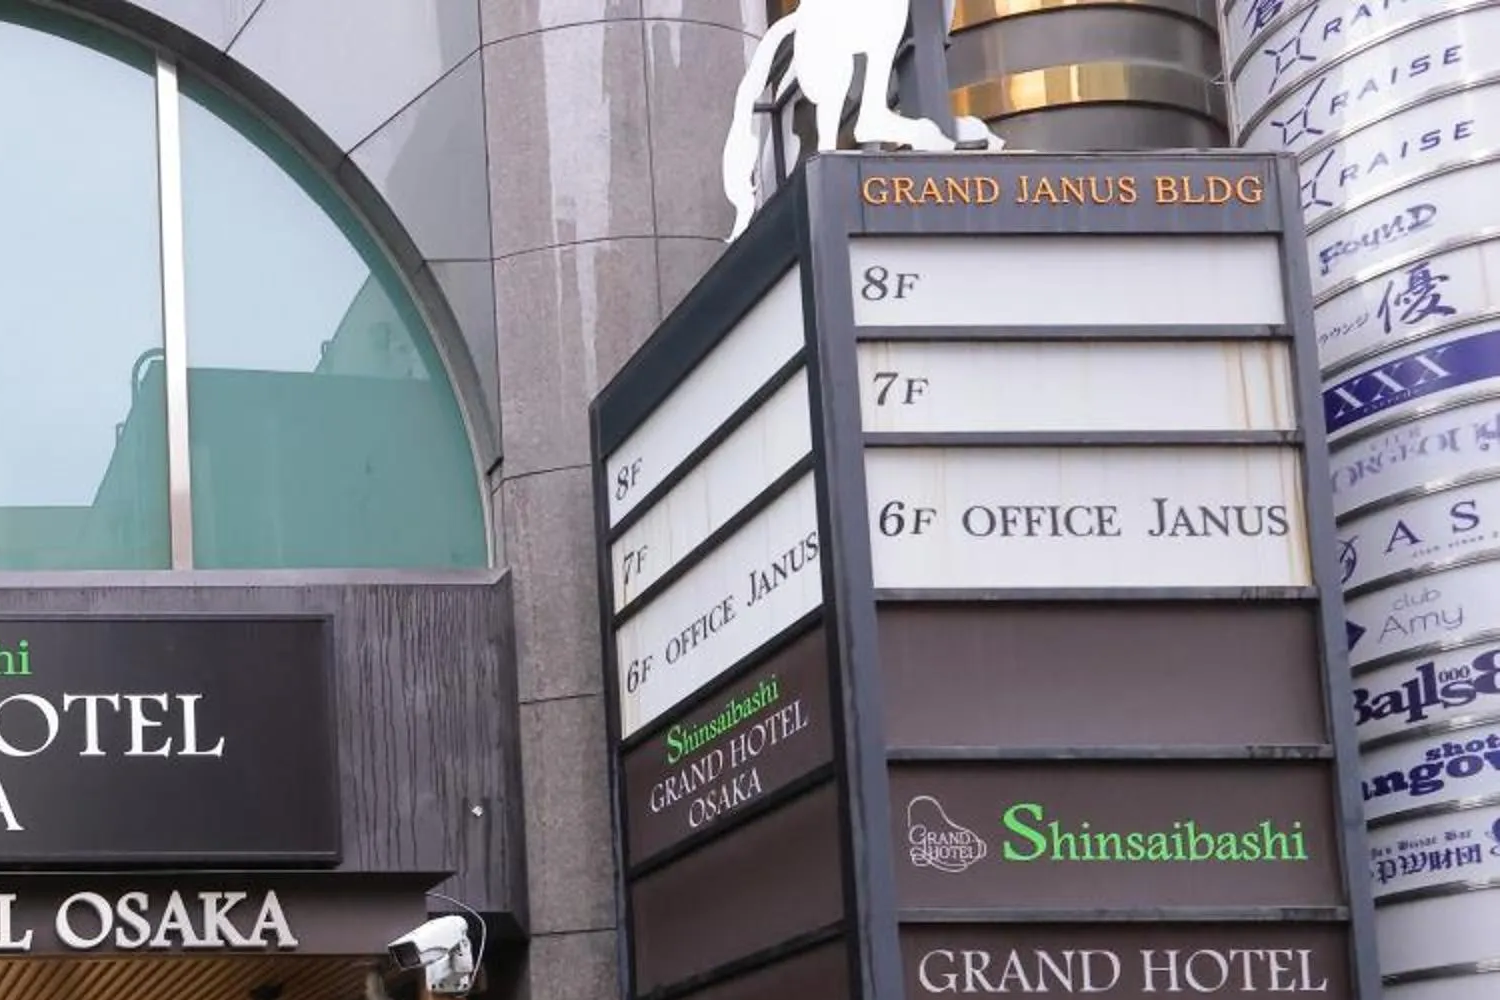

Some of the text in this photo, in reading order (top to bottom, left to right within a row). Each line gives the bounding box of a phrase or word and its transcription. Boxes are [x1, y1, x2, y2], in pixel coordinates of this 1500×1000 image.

[1329, 44, 1462, 116] RAISE
[1339, 119, 1474, 188] RAISE
[862, 175, 1263, 206] GRAND JANUS BLDG
[861, 266, 920, 301] 8F
[1377, 262, 1457, 334] 優
[873, 372, 929, 406] 7F
[1334, 348, 1451, 419] XXX
[615, 458, 643, 501] 8F
[878, 498, 1290, 538] 6F OFFICE JANUS
[623, 545, 648, 586] 7F
[627, 532, 819, 693] 6F OFFICE JANUS
[1378, 605, 1464, 643] Amy
[1393, 587, 1442, 611] club
[666, 674, 779, 764] Shinsaibashi
[650, 700, 810, 813] GRAND HOTEL
[688, 767, 762, 828] OSAKA
[909, 824, 973, 855] GRAND
[1002, 803, 1309, 862] Shinsaibashi
[54, 889, 299, 950] OSAKA
[918, 948, 1328, 994] GRAND HOTEL
